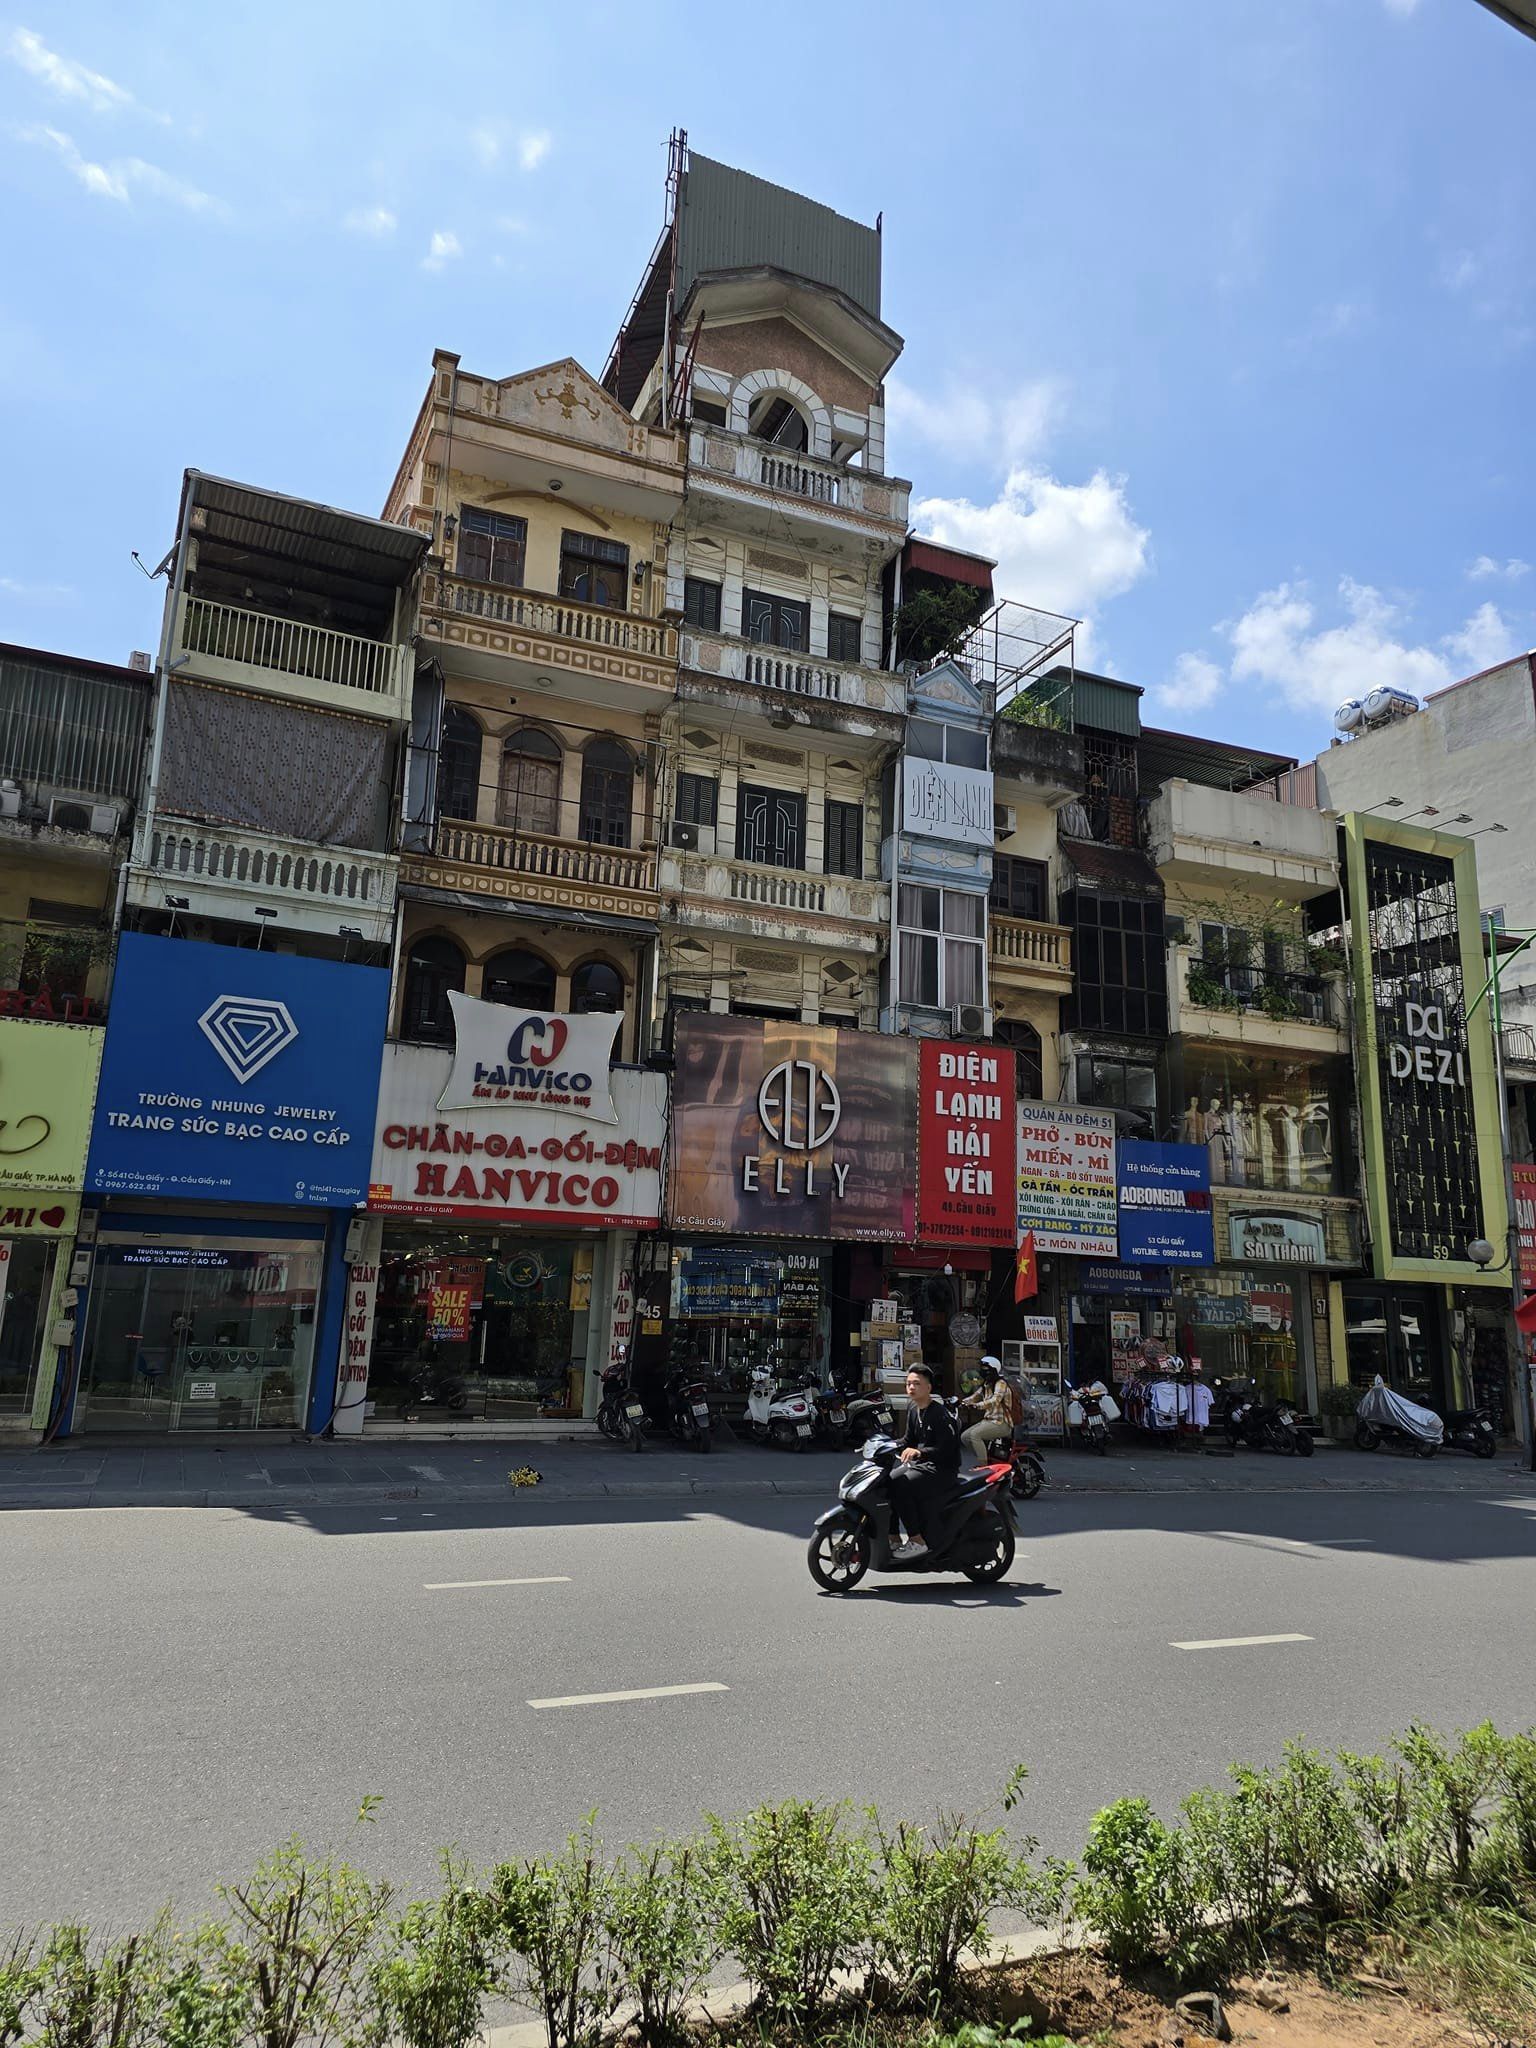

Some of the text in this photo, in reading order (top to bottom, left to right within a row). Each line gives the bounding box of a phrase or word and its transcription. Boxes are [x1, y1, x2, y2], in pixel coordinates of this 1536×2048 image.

[910, 768, 992, 837] ĐIỆN LẠNH
[938, 1050, 998, 1087] ĐIỆN
[1389, 1042, 1466, 1087] DEZI
[138, 1091, 337, 1122] TRƯỜNG NHUNG JEWELRY
[936, 1090, 1001, 1122] LẠNH
[1023, 1107, 1112, 1128] QUÁN ĂN ĐÊM 51
[107, 1112, 351, 1147] TRANG SỨC BẠC CAO CẤP
[1021, 1125, 1113, 1149] PHỞ BÚN
[947, 1123, 990, 1157] HẢI
[1088, 1154, 1109, 1170] MÌ
[1127, 1163, 1139, 1174] Hệ
[1140, 1163, 1164, 1176] thống
[1180, 1167, 1201, 1179] hàng
[61, 1174, 76, 1184] NỘI
[414, 1161, 620, 1207] HANVICO
[743, 1155, 851, 1199] ELLY
[944, 1161, 993, 1195] YẾN
[1021, 1167, 1042, 1177] NGAN
[1095, 1174, 1114, 1184] VANG
[373, 1203, 413, 1212] SHOWROOM
[675, 1215, 688, 1225] 45
[707, 1216, 726, 1228] Giấy
[1045, 1220, 1073, 1231] RANG
[857, 1227, 907, 1238] www.elly.vn
[1081, 1241, 1113, 1254] NHẬU
[1244, 1236, 1269, 1259] SÀI
[1432, 1245, 1449, 1260] 59
[123, 1255, 151, 1263] TRANG
[355, 1291, 367, 1308] GA
[432, 1290, 468, 1308] SALE
[1316, 1299, 1326, 1314] 57
[349, 1309, 366, 1332] GỐI
[433, 1308, 465, 1326] 50%
[643, 1304, 661, 1319] 45
